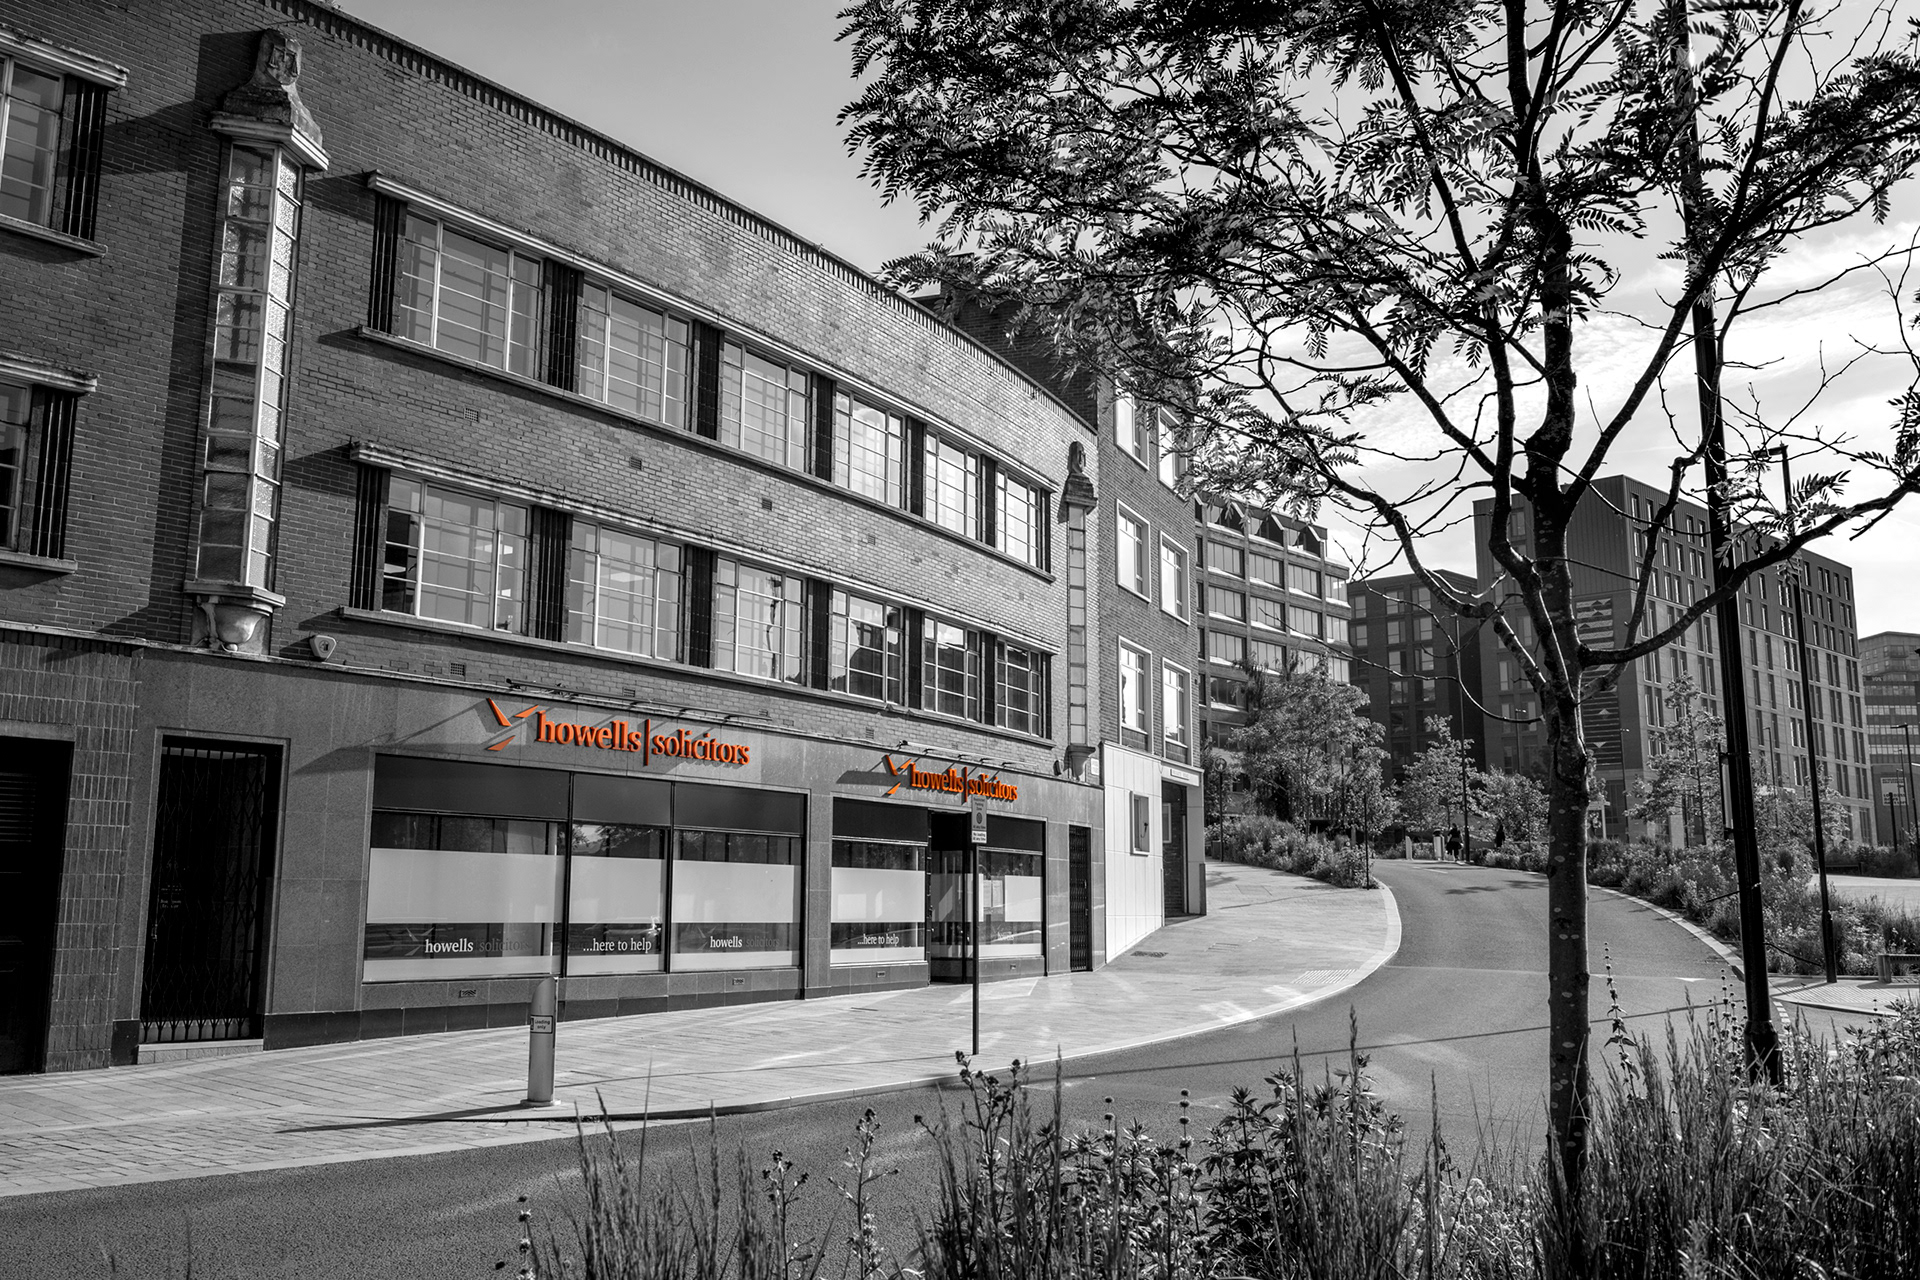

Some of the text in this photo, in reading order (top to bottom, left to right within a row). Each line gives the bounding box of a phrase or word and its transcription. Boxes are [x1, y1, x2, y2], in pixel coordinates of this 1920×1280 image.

[536, 710, 751, 765] howells solicitors
[910, 762, 1018, 800] howells solicitors
[424, 938, 474, 953] howells
[618, 939, 628, 951] to
[631, 937, 652, 954] help
[709, 936, 743, 948] howells
[878, 935, 885, 945] to
[886, 933, 899, 946] help
